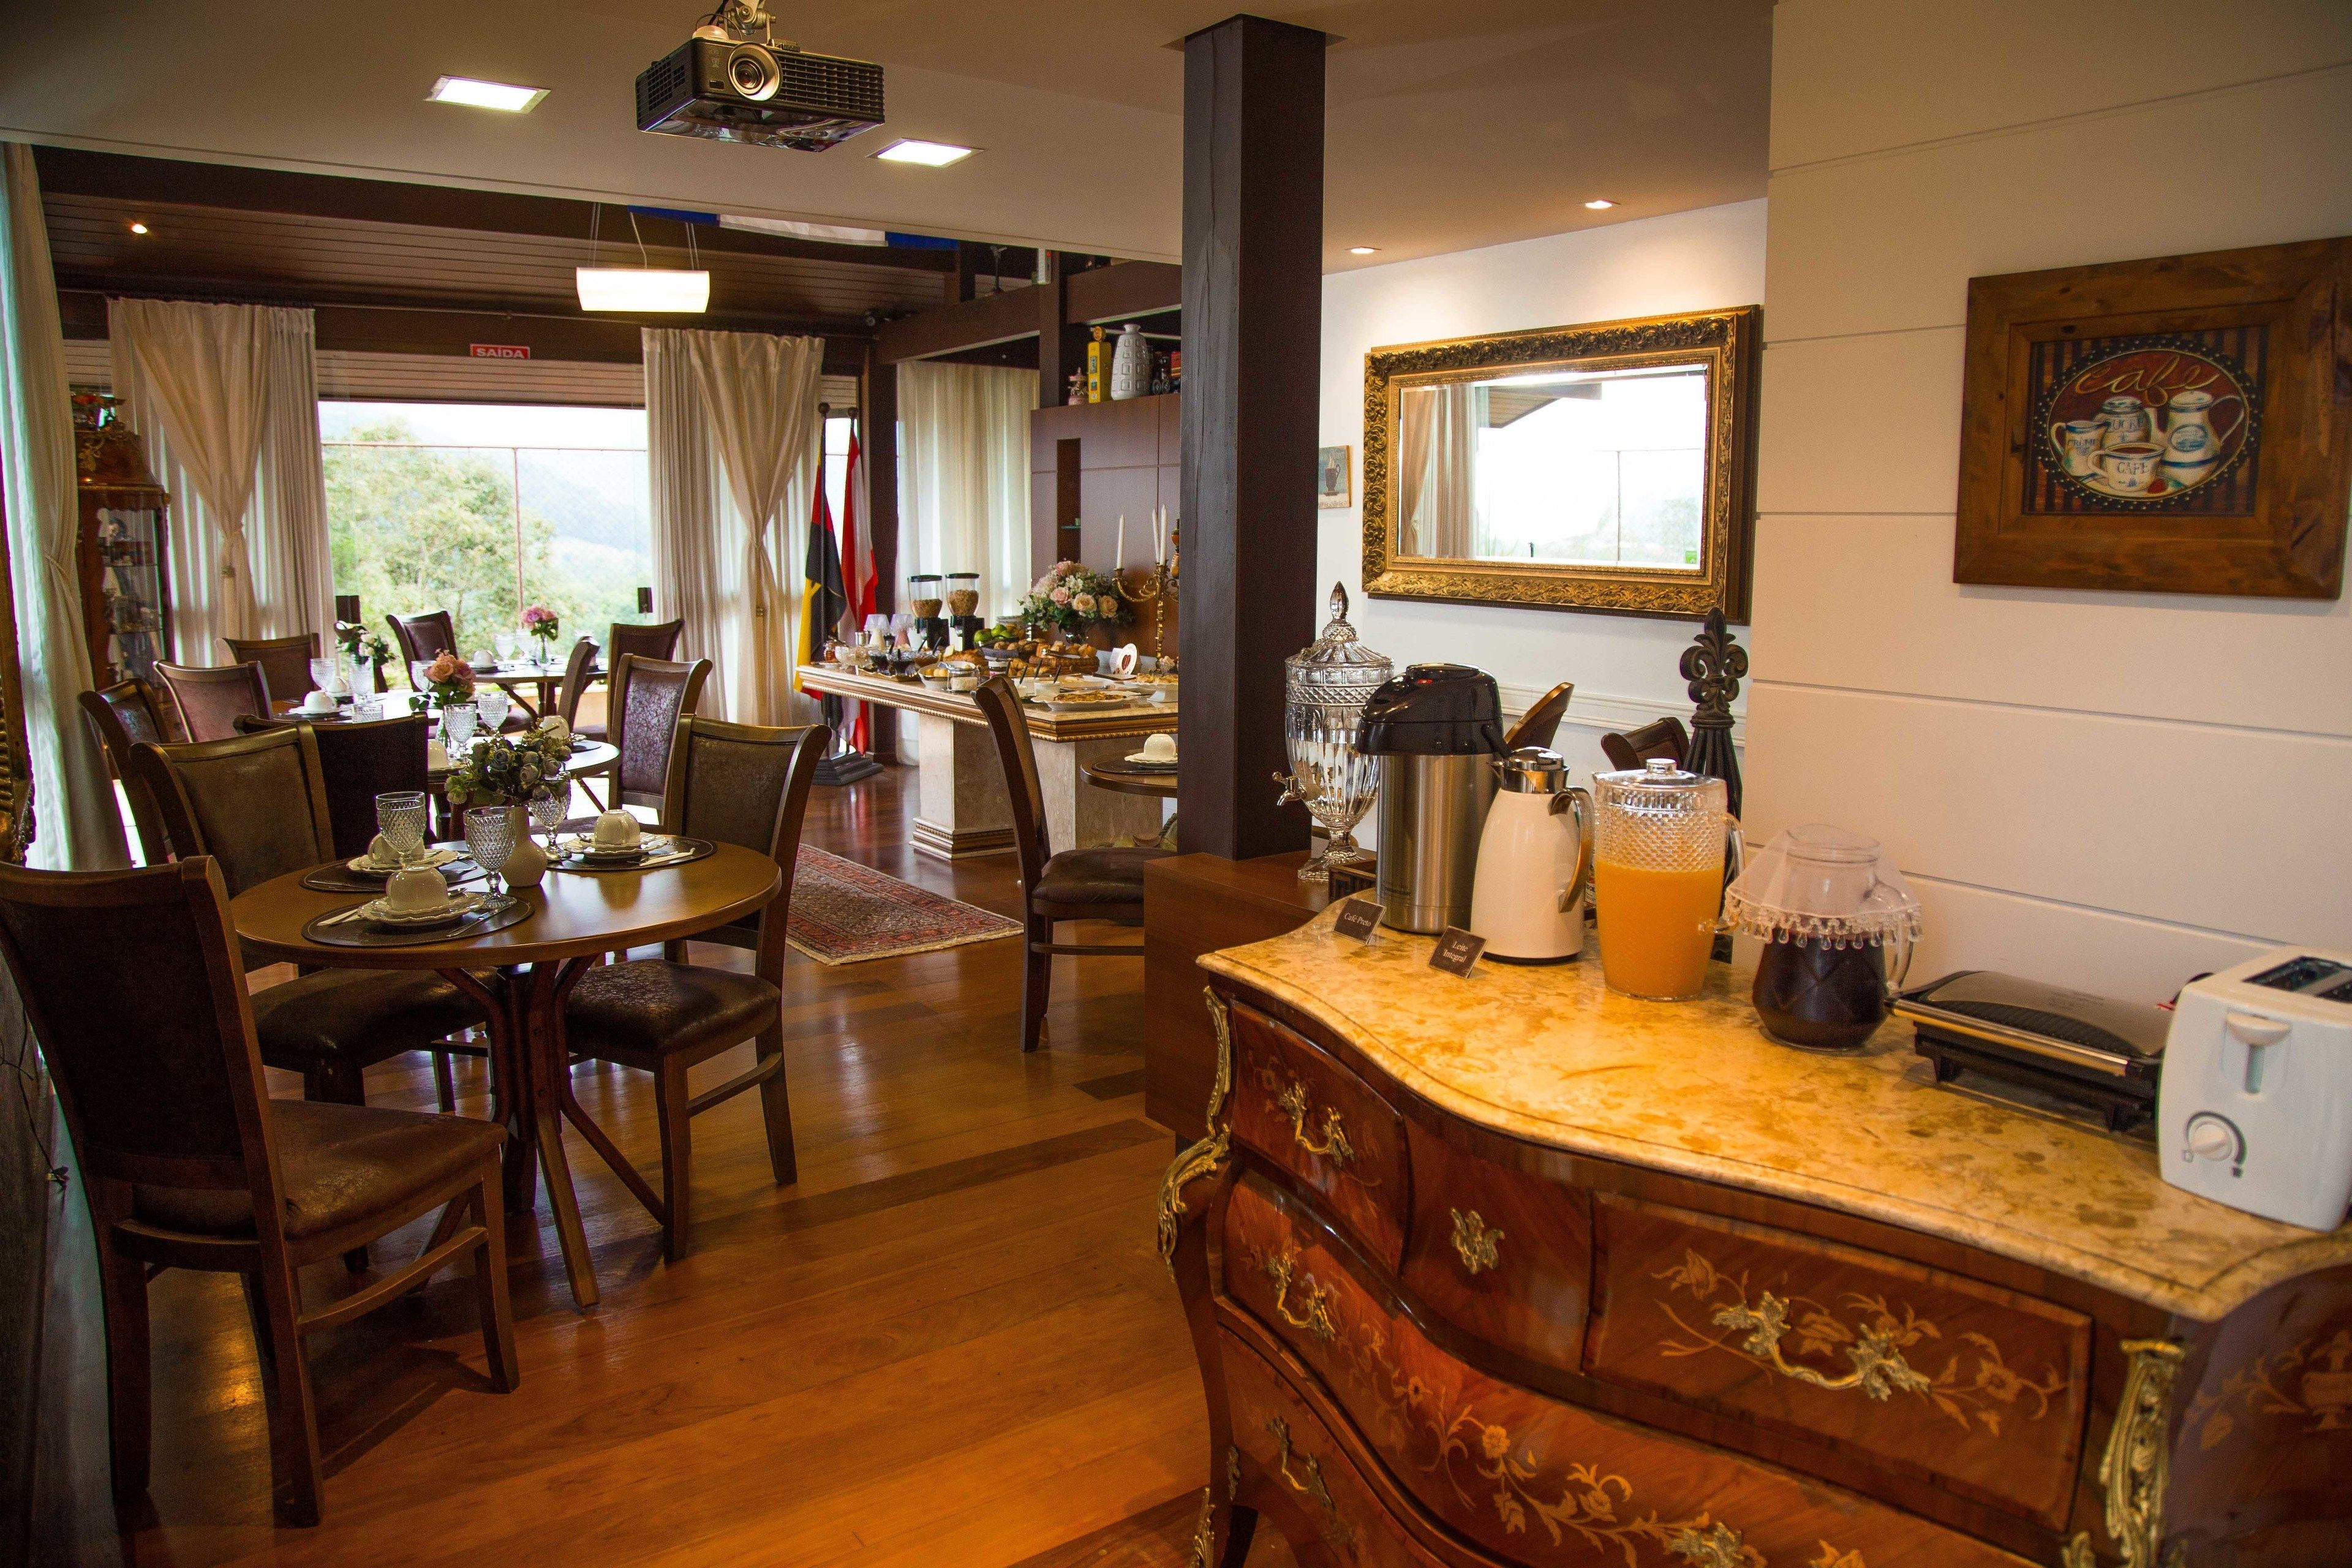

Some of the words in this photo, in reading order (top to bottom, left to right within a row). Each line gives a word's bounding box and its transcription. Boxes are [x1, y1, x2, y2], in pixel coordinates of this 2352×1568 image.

[1344, 913, 1357, 922] Café
[1357, 916, 1371, 927] Preto
[1452, 941, 1468, 952] Leite
[1443, 949, 1467, 963] Integral
